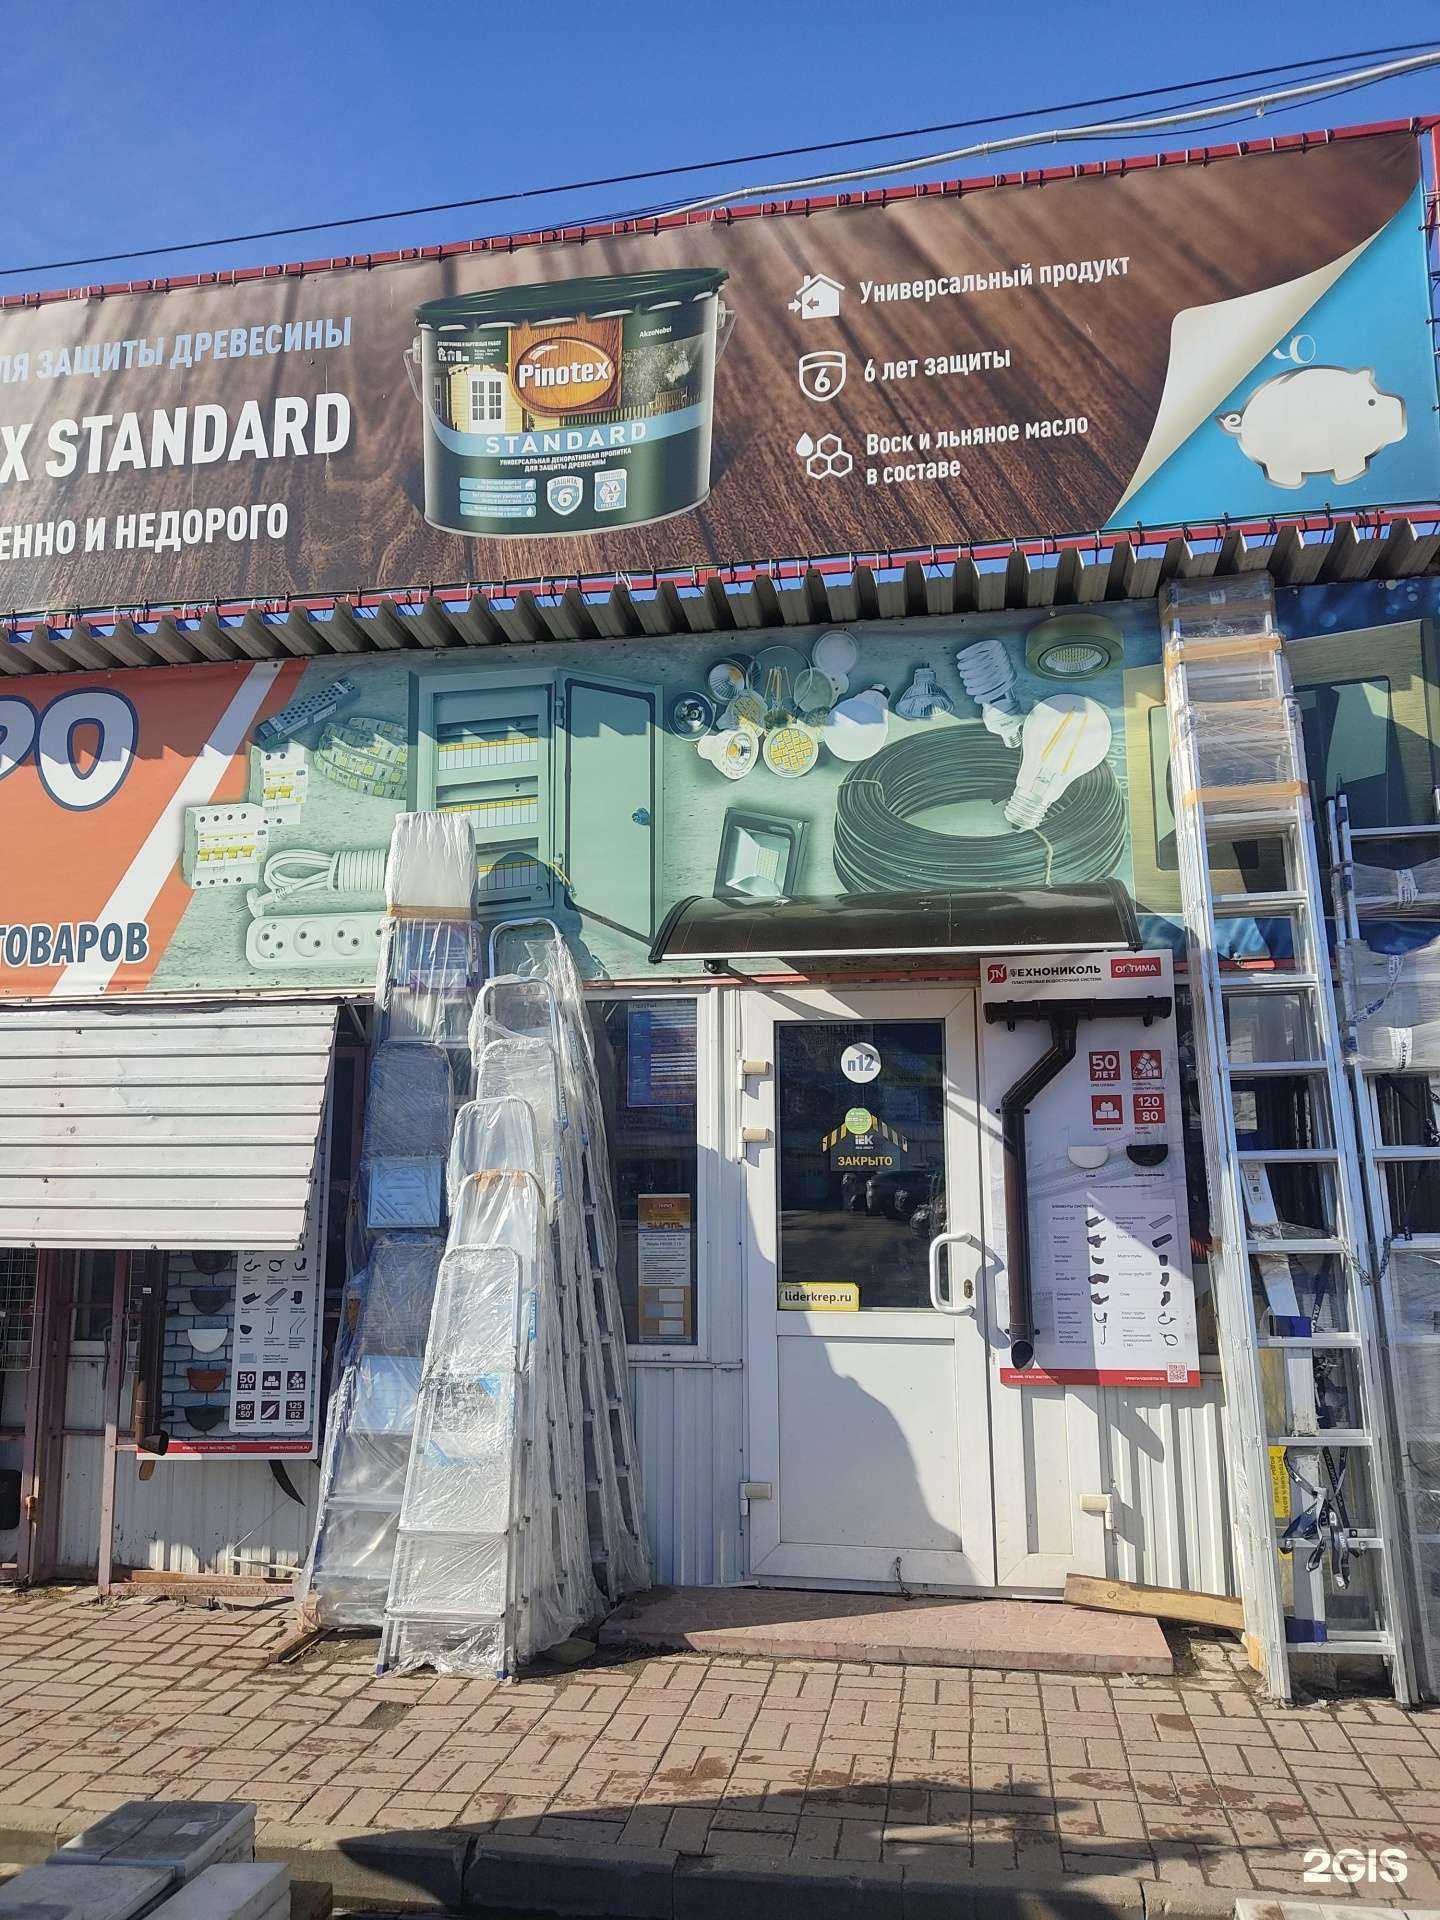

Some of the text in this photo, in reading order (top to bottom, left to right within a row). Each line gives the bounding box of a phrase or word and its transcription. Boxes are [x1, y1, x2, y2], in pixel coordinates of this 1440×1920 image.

[859, 256, 1130, 305] Универсальный продукт
[37, 337, 164, 379] ЗАЩИТЫ
[170, 316, 352, 369] ДРЕВЕСИНЫ
[518, 361, 609, 389] Pinotex
[864, 349, 1011, 383] 6 лет защиты
[815, 368, 830, 392] 6
[0, 392, 352, 484] X STANDARD
[485, 422, 647, 455] STANDARD
[866, 414, 1089, 456] Воск и льняное масло
[539, 462, 567, 471] ЗАЩИТЫ
[567, 459, 607, 469] ДРЕВЕСИНЫ
[551, 453, 600, 464] ДЕКОРАТИВНАЯ
[600, 448, 631, 458] ПРОПИТКА
[866, 458, 961, 486] в составе
[0, 503, 288, 560] ЕННО И НЕДОРОГО
[1092, 1055, 1117, 1070] 50
[1138, 1097, 1160, 1107] 120
[1142, 1111, 1158, 1121] 80
[838, 1156, 893, 1166] ЗАКРЫТО
[784, 1291, 852, 1304] liderkrep.ru
[239, 1373, 255, 1384] 50
